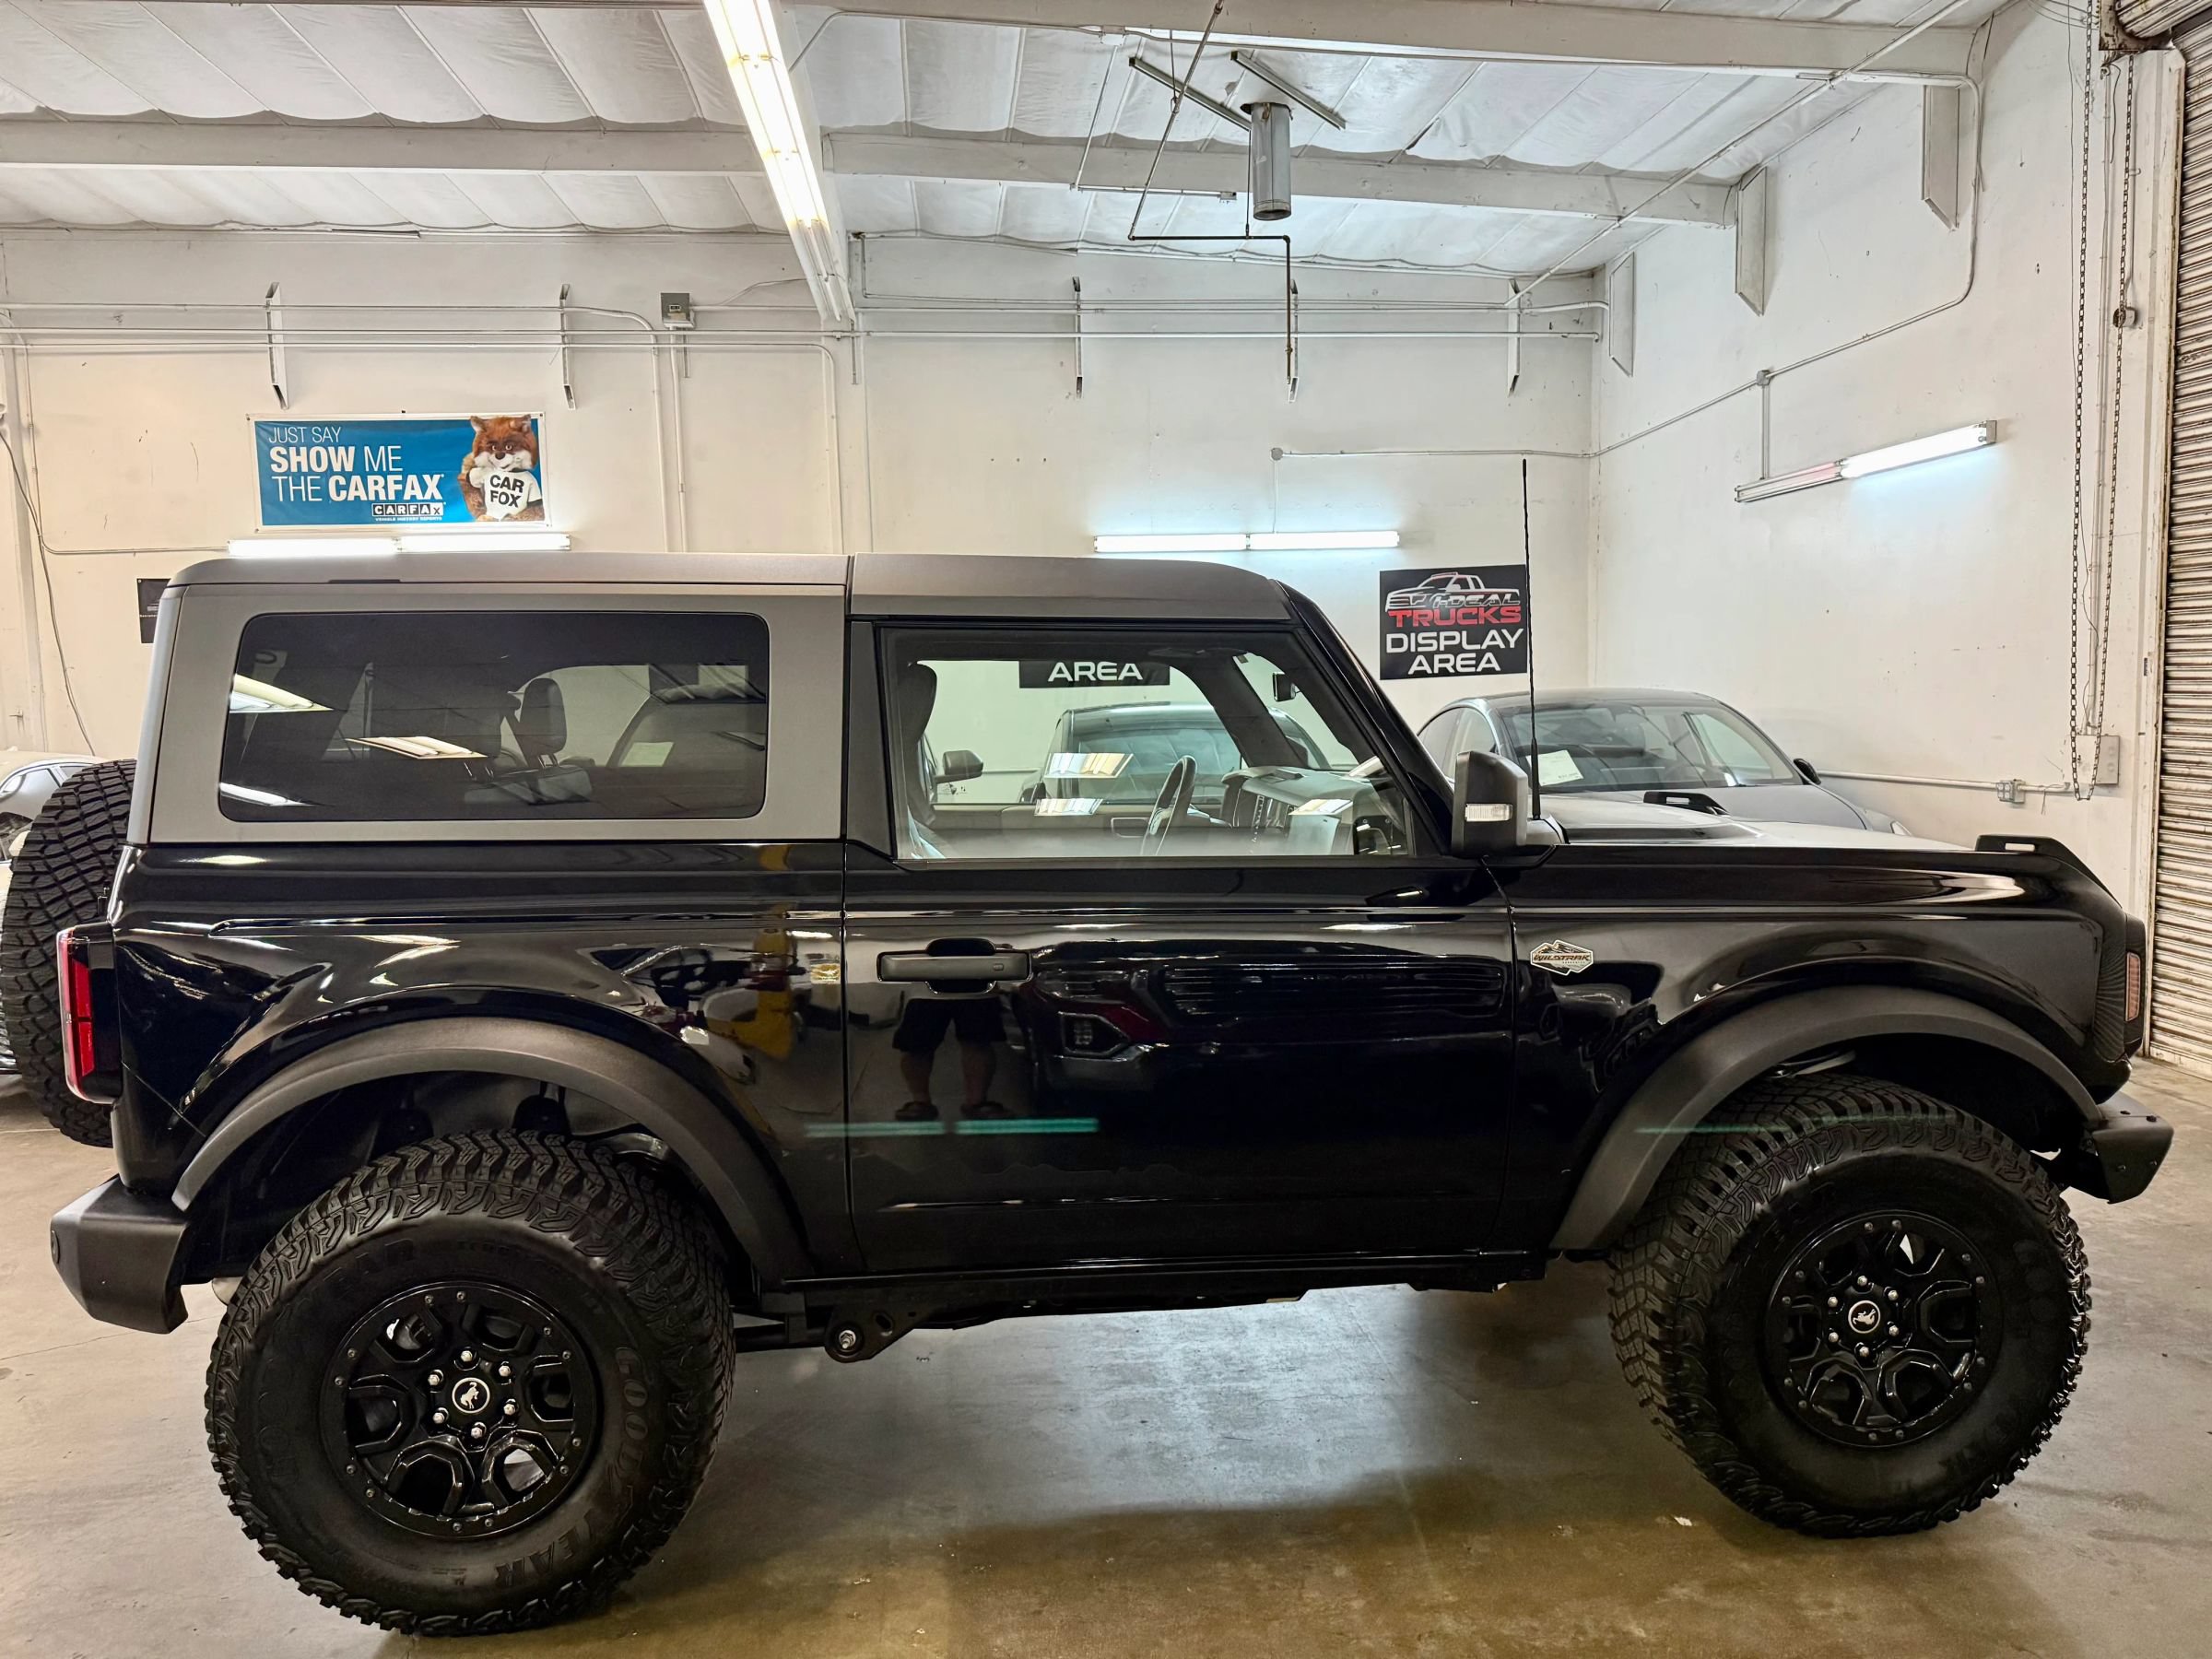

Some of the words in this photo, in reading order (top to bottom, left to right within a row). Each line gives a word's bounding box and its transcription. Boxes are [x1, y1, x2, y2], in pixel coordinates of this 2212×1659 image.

[268, 427, 307, 443] JUST
[312, 427, 341, 443] SAY
[269, 446, 356, 473] SHOW
[364, 445, 404, 472] ME
[271, 476, 323, 502] THE
[328, 474, 443, 501] CARFAX
[489, 474, 524, 493] CAR
[490, 489, 522, 508] FOX
[1387, 606, 1522, 628] TRUCKS
[1385, 628, 1524, 653] DISPLAY
[1047, 661, 1144, 682] AREA
[1407, 652, 1501, 675] AREA
